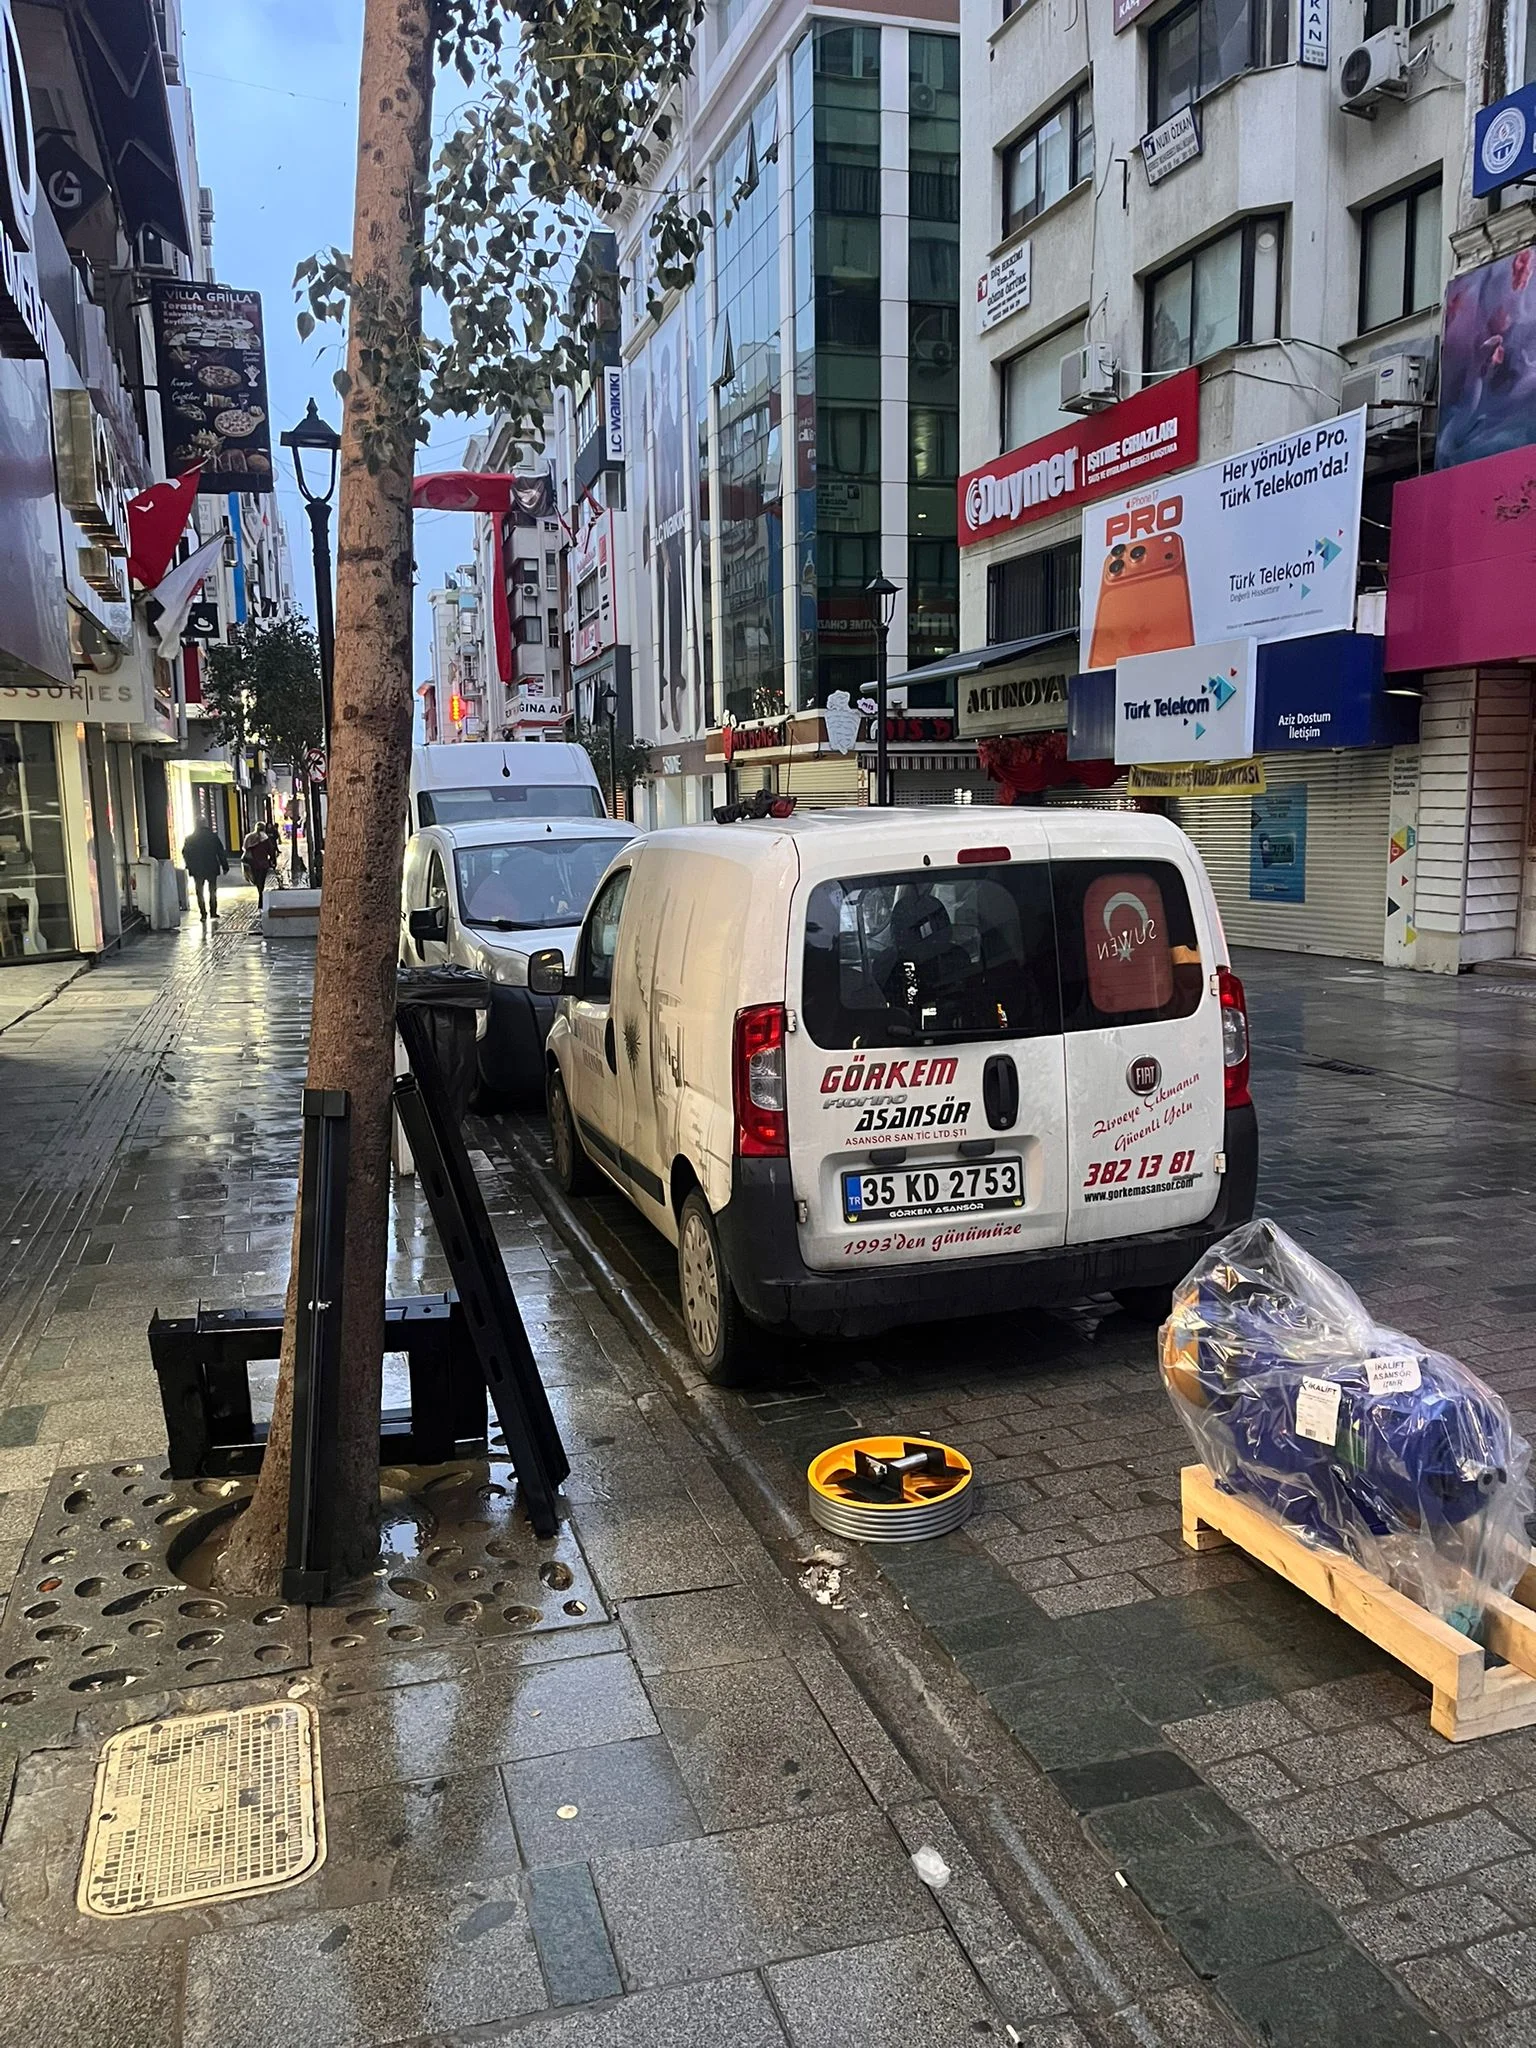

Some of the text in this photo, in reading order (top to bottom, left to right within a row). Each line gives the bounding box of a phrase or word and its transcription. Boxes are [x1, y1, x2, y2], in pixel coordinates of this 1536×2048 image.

[611, 433, 622, 453] LC
[1222, 429, 1348, 484] Her yönüyle Pro.
[978, 445, 1079, 526] Duymer
[1219, 452, 1349, 511] Türk Telekom'da!
[1105, 495, 1184, 547] PRO
[1229, 560, 1315, 592] Türk Telekom
[1123, 696, 1210, 720] Türk Telekom
[1278, 712, 1331, 726] Aziz Dostum
[1288, 725, 1321, 741] İletişim
[819, 1054, 959, 1094] GÖRKEM
[1135, 1066, 1155, 1086] FIAT
[1143, 1072, 1200, 1113] Çıkmanın
[1114, 1102, 1193, 1152] Güvenli Yolu
[1083, 1149, 1196, 1188] 382 13 81
[849, 1196, 861, 1206] TR
[862, 1165, 1017, 1207] 35 KD 2753
[1084, 1178, 1194, 1203] www.gorkemasansor.com
[889, 1202, 985, 1219] GÖRKEM ASANSÖR
[843, 1223, 1022, 1255] 1993'den günümüze
